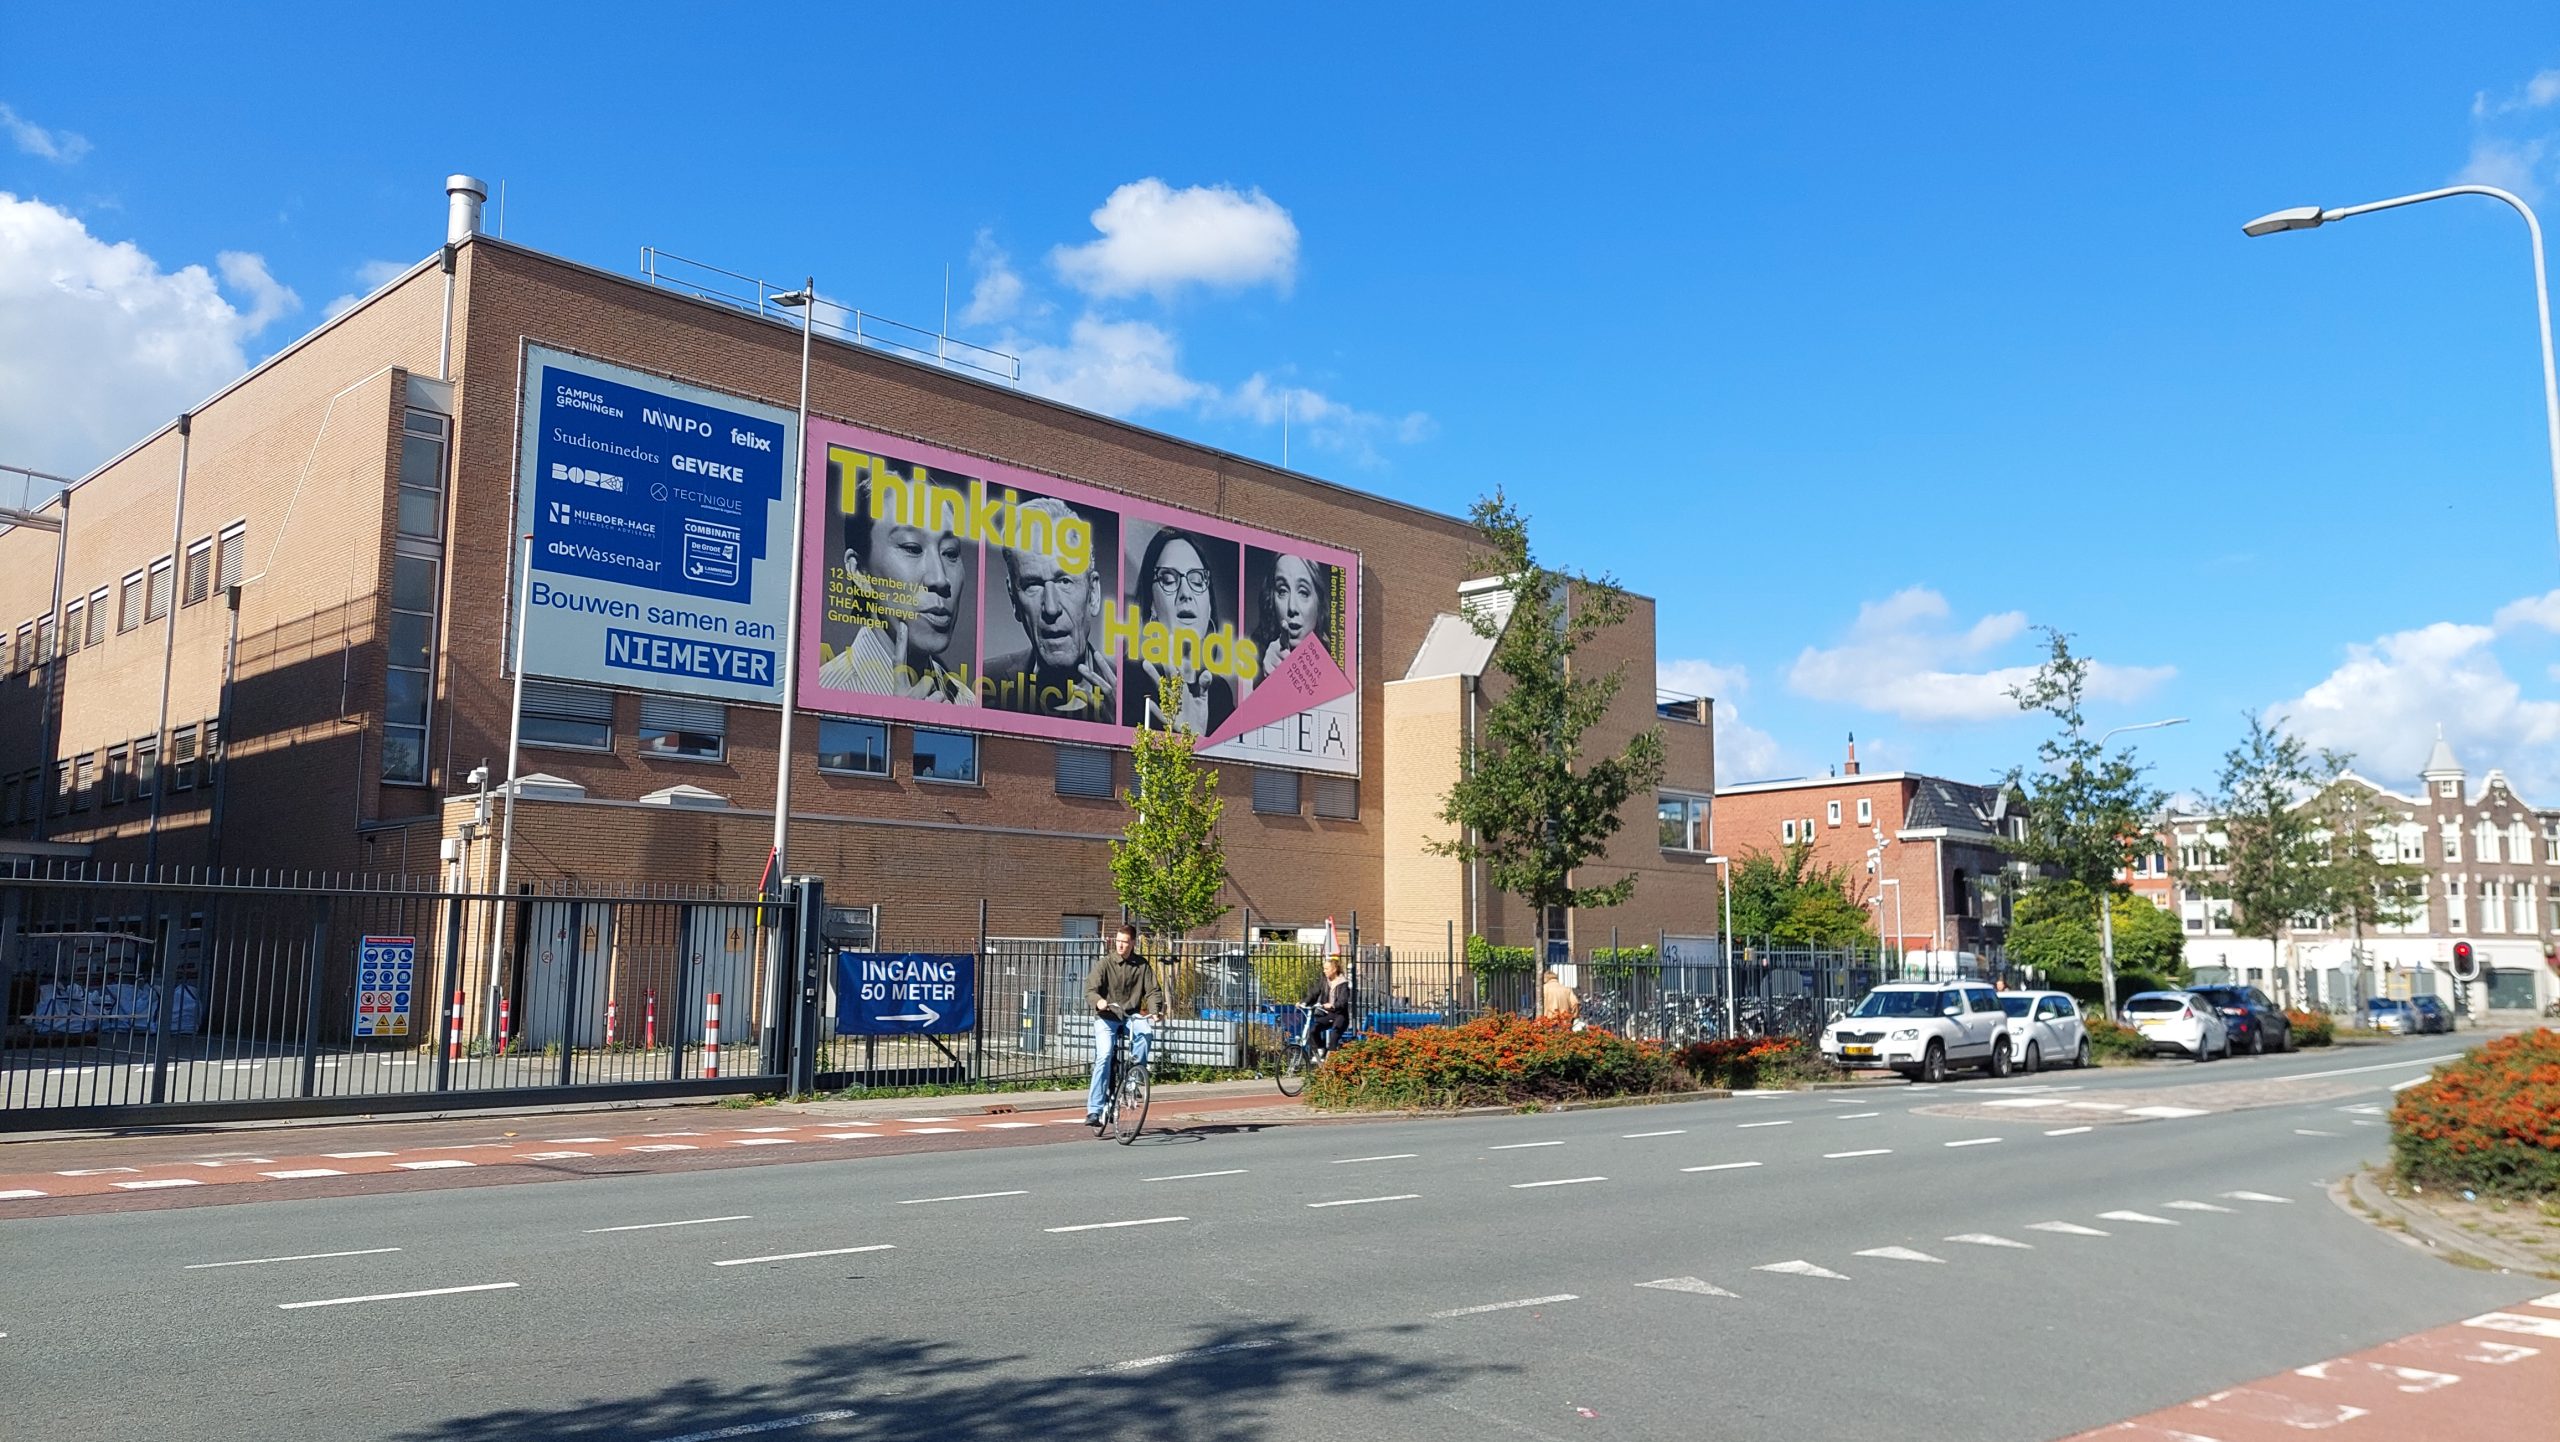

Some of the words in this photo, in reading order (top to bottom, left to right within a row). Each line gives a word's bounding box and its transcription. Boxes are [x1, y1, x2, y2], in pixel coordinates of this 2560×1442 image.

[557, 386, 603, 403] CAMPUS
[556, 395, 623, 418] GRONINGEN
[553, 428, 659, 464] Studioninedots
[731, 428, 771, 452] felixx
[672, 455, 743, 483] GEVEKE
[673, 488, 742, 511] TECTNIQUE
[574, 510, 656, 533] NIJEBOER-HAGE
[829, 447, 1092, 576] Thinking
[574, 519, 614, 530] TECHNISCH
[684, 523, 740, 540] COMBINATIE
[548, 541, 662, 572] abtWassenaar
[691, 542, 701, 550] De
[702, 544, 721, 553] Groot
[829, 581, 843, 593] 30
[846, 586, 890, 601] oktober
[830, 567, 844, 579] 12
[909, 583, 929, 594] t/m
[532, 582, 639, 620] Bouwen
[647, 606, 728, 633] samen
[735, 620, 775, 640] aan
[828, 595, 863, 612] THEA,
[866, 602, 920, 620] Niemeyer
[828, 610, 888, 629] Groningen
[1103, 600, 1260, 680] Hands
[609, 633, 769, 681] NIEMEYER
[1302, 650, 1315, 666] you
[1287, 667, 1303, 694] THEA
[1291, 662, 1314, 695] opened
[862, 960, 956, 982] INGANG
[860, 983, 885, 1000] 50
[892, 984, 955, 1000] METER
